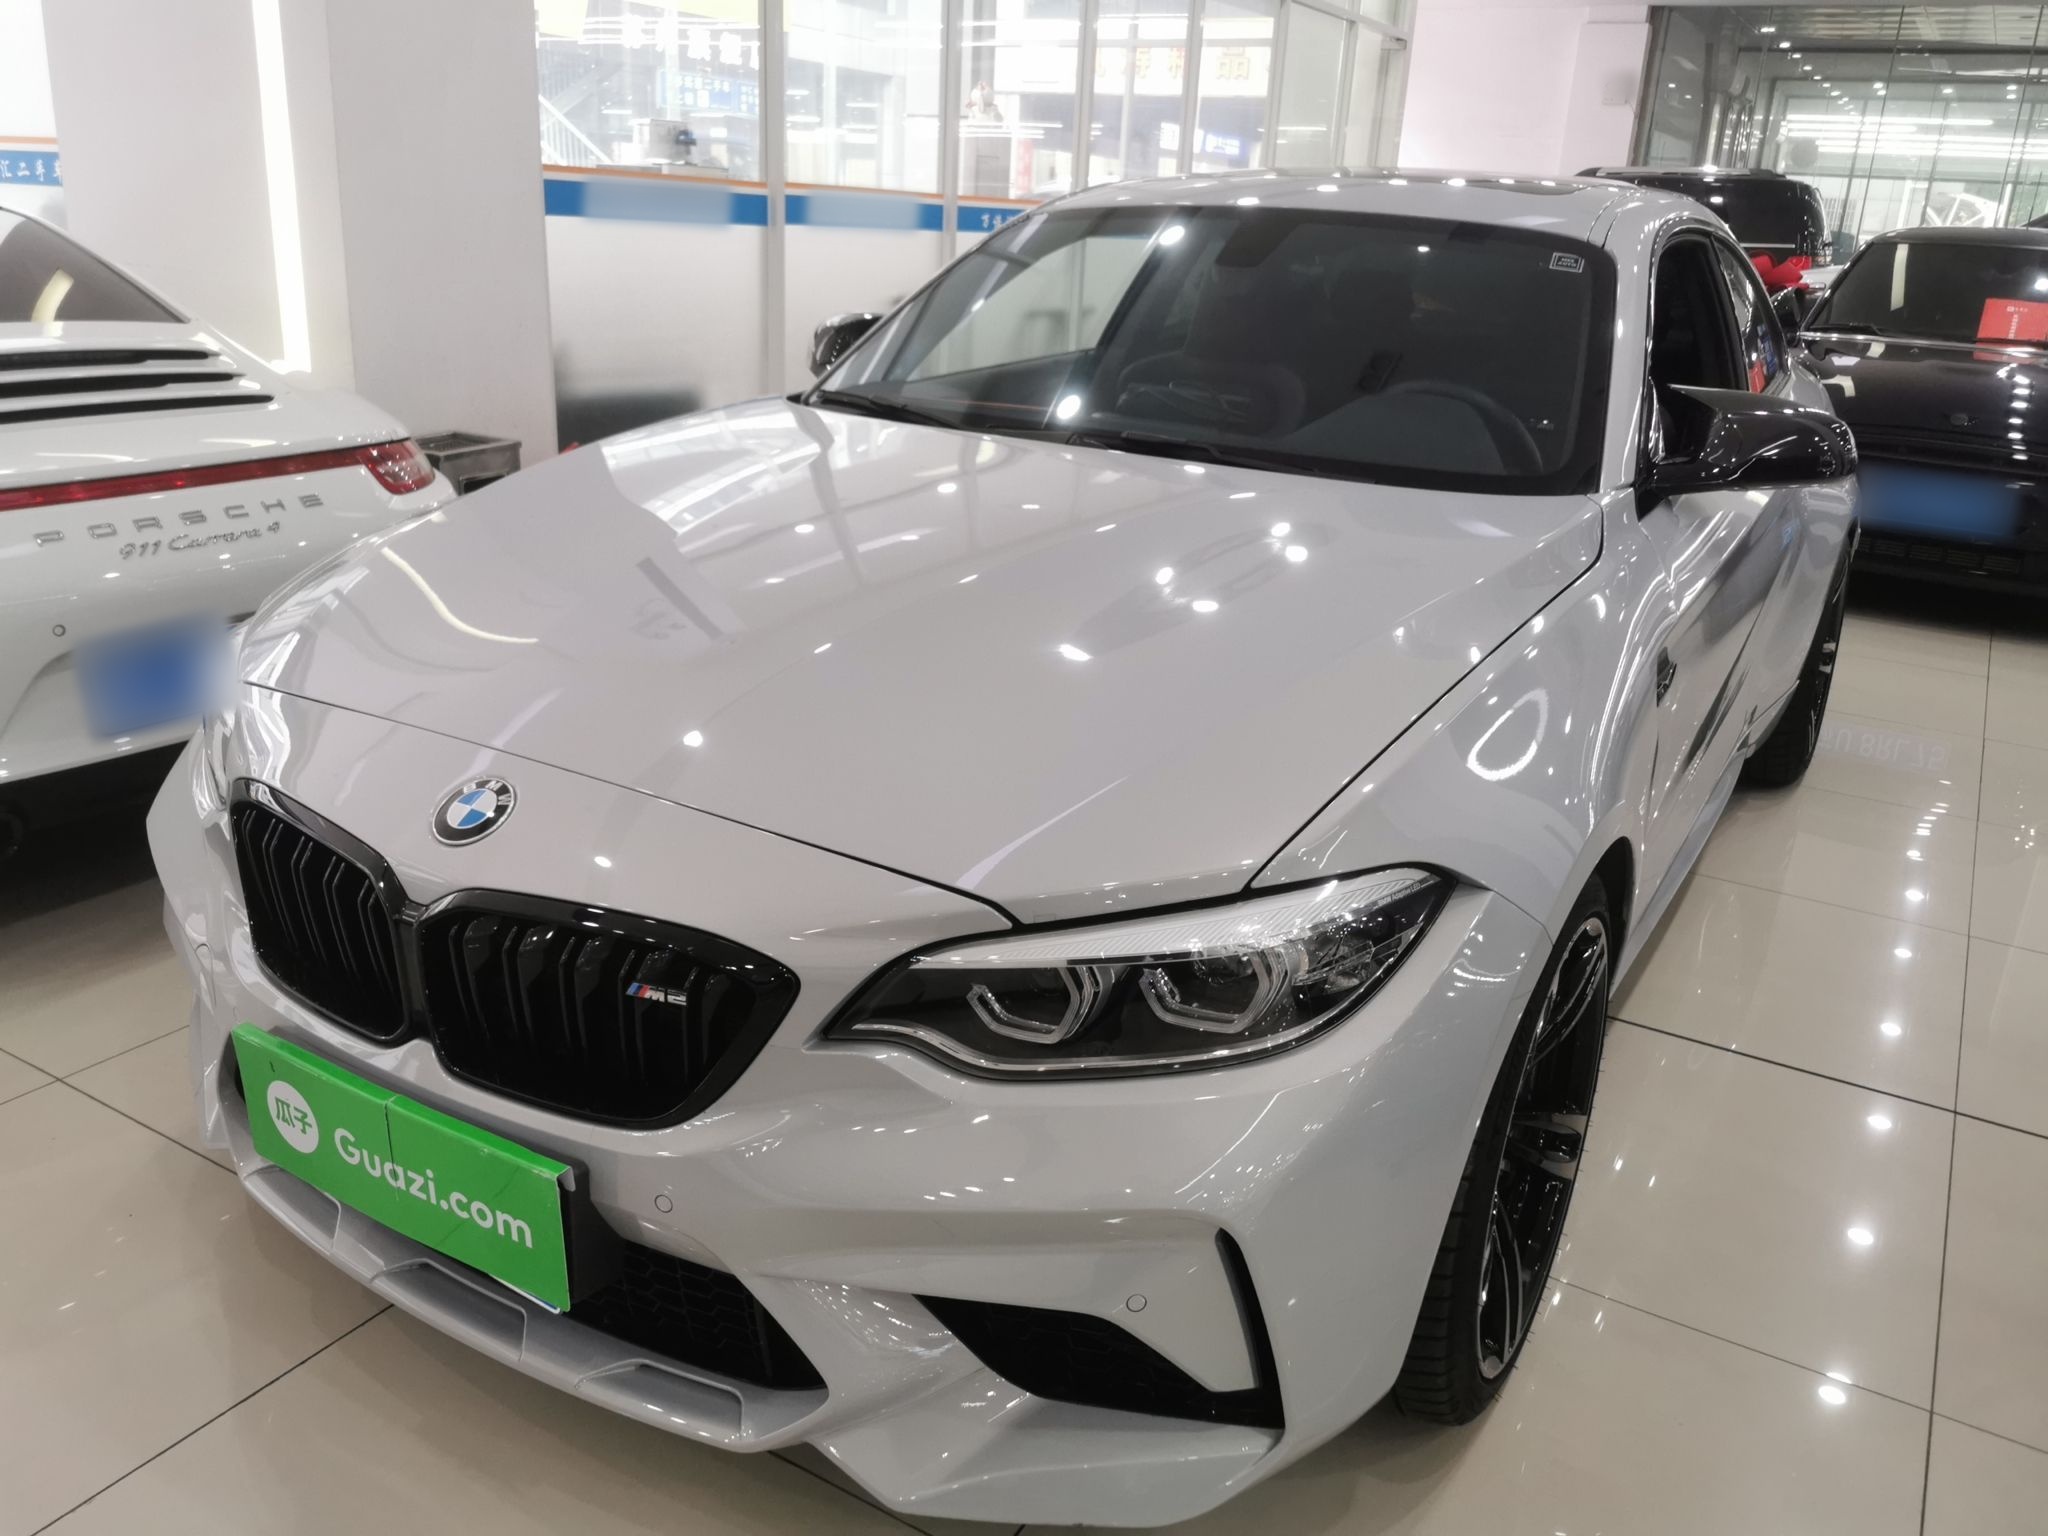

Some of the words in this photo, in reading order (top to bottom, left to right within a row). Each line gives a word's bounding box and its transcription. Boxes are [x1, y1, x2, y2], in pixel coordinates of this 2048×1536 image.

[34, 493, 325, 547] PORSCHE
[118, 539, 161, 561] 911
[168, 524, 262, 553] Carrera
[265, 521, 282, 537] 4
[463, 780, 512, 806] BMW
[643, 986, 688, 1006] M2
[274, 1096, 313, 1133] 瓜子
[334, 1126, 534, 1249] Guazi.com
